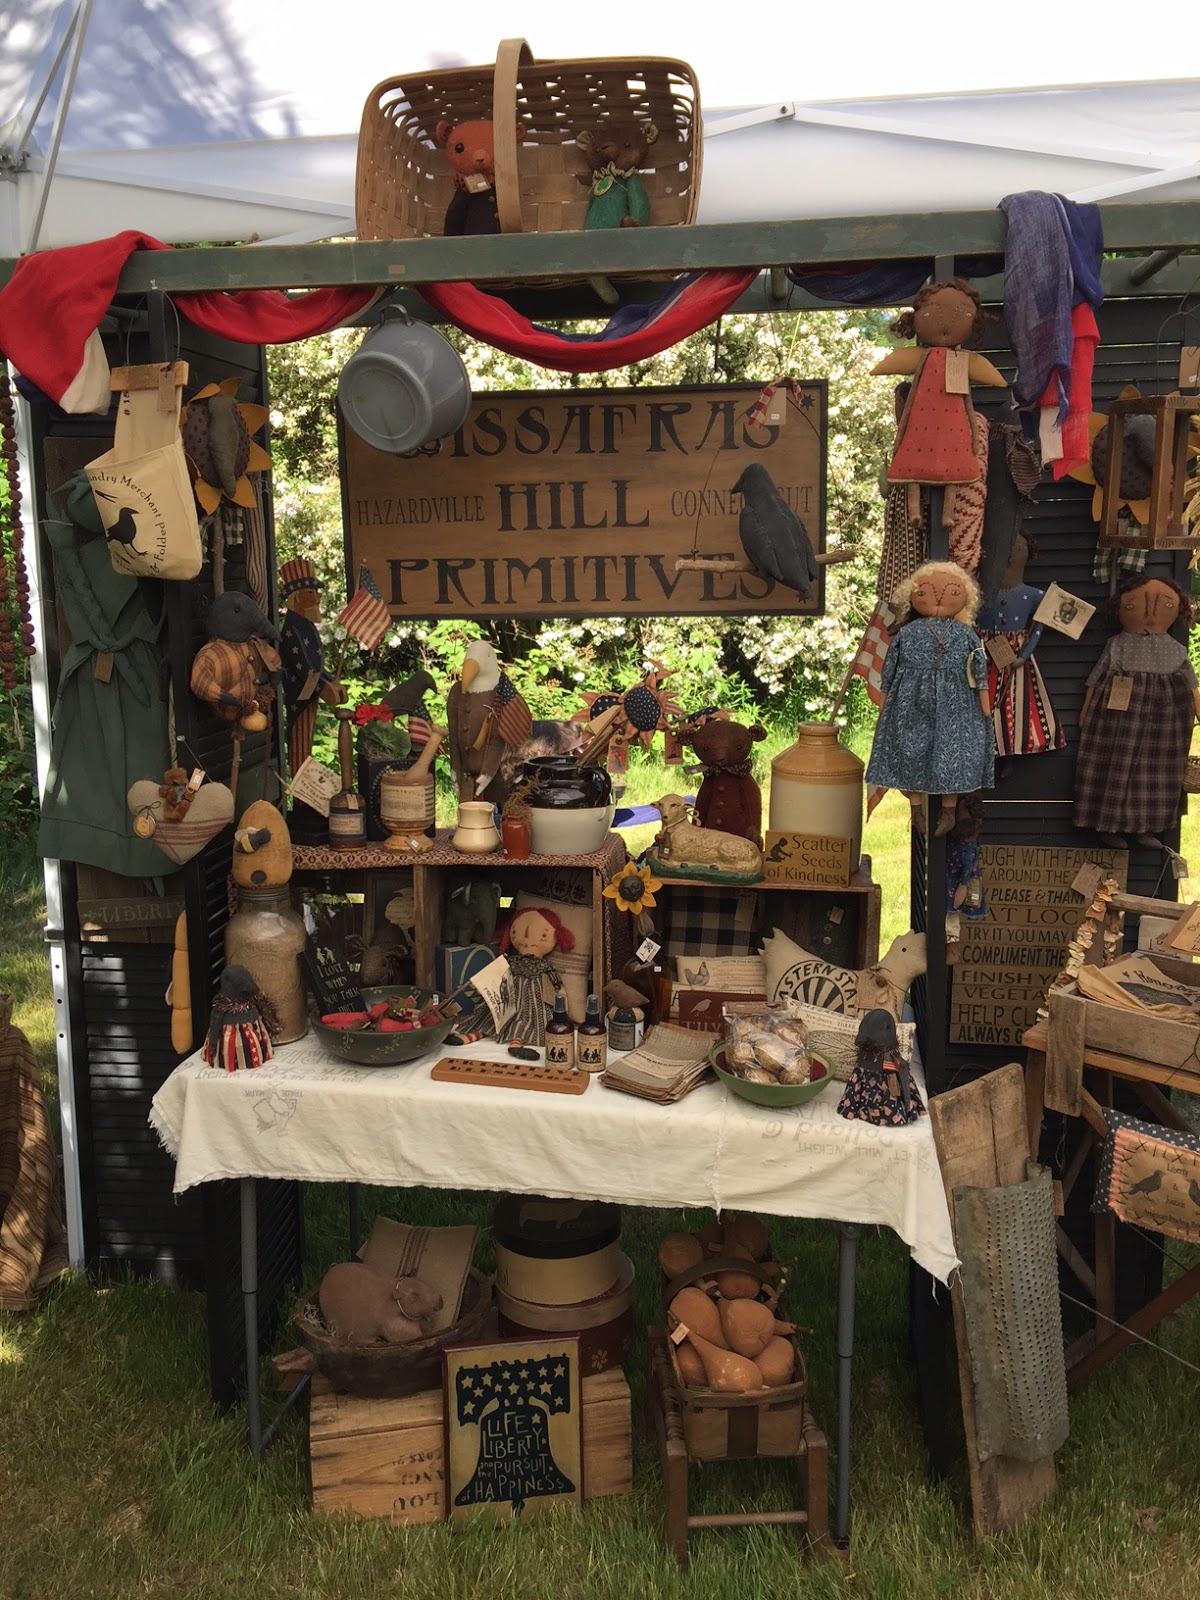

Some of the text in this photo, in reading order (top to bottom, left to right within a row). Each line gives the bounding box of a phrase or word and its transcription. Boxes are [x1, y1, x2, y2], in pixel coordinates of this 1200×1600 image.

[398, 401, 780, 459] SSAFRAS
[120, 474, 162, 519] Merchant
[356, 480, 813, 532] HAZARDVILLE HILL CONNEUT
[153, 521, 167, 562] Folded
[792, 834, 847, 853] Scatter
[800, 853, 842, 869] Seeds
[977, 846, 1118, 869] AUGH WITH FAMILY
[767, 865, 847, 885] of Kindness
[989, 867, 1041, 883] AROUND
[1046, 870, 1074, 885] THE
[990, 888, 1032, 903] PLEASE
[1035, 889, 1046, 904] &
[100, 901, 186, 922] LIBERTY
[1027, 908, 1078, 925] LOC
[966, 926, 991, 941] TRY
[992, 927, 1003, 941] IT
[1007, 928, 1035, 943] YOU
[1038, 930, 1069, 944] MAY
[962, 945, 1066, 967] COMPLIMENT THE
[324, 962, 344, 977] LOVE
[961, 970, 1033, 985] FINISH
[778, 963, 838, 1000] ASTERN
[339, 987, 360, 1001] TALK
[964, 986, 1048, 1001] VEGETA
[958, 1004, 1005, 1024] HELP
[958, 1026, 1011, 1044] ALWAYS
[244, 1089, 304, 1098] TRADE MARK
[798, 1142, 847, 1156] WEIGHT
[487, 1411, 529, 1437] LIFE
[482, 1426, 543, 1459] LIBERTY
[493, 1453, 549, 1479] PURSUIT
[461, 1475, 565, 1502] of HAPPINESS
